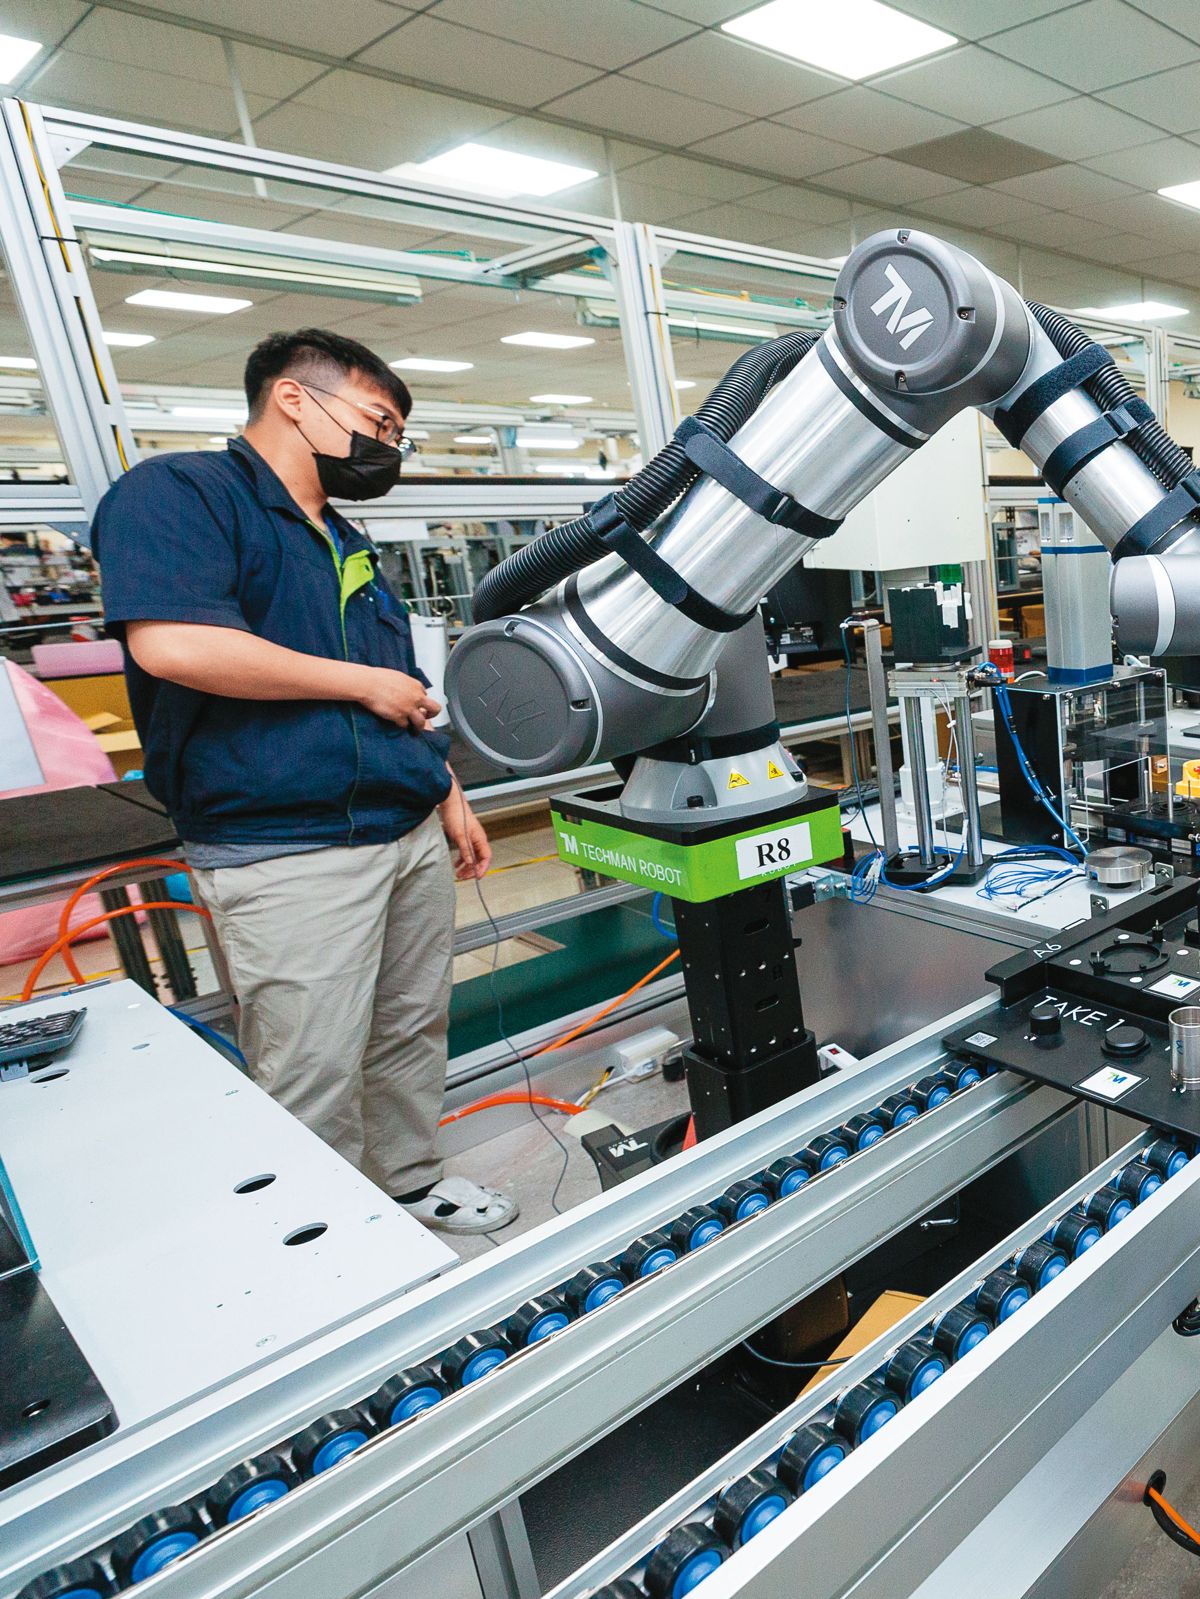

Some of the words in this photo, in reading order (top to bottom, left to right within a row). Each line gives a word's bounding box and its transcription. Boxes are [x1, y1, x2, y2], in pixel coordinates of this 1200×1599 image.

[560, 832, 579, 855] TM
[581, 842, 637, 872] TECHMAN
[639, 859, 681, 886] ROBOT
[755, 838, 791, 868] R8
[1033, 943, 1061, 958] A6
[1034, 995, 1108, 1026] TAKE
[1105, 1018, 1126, 1032] 1
